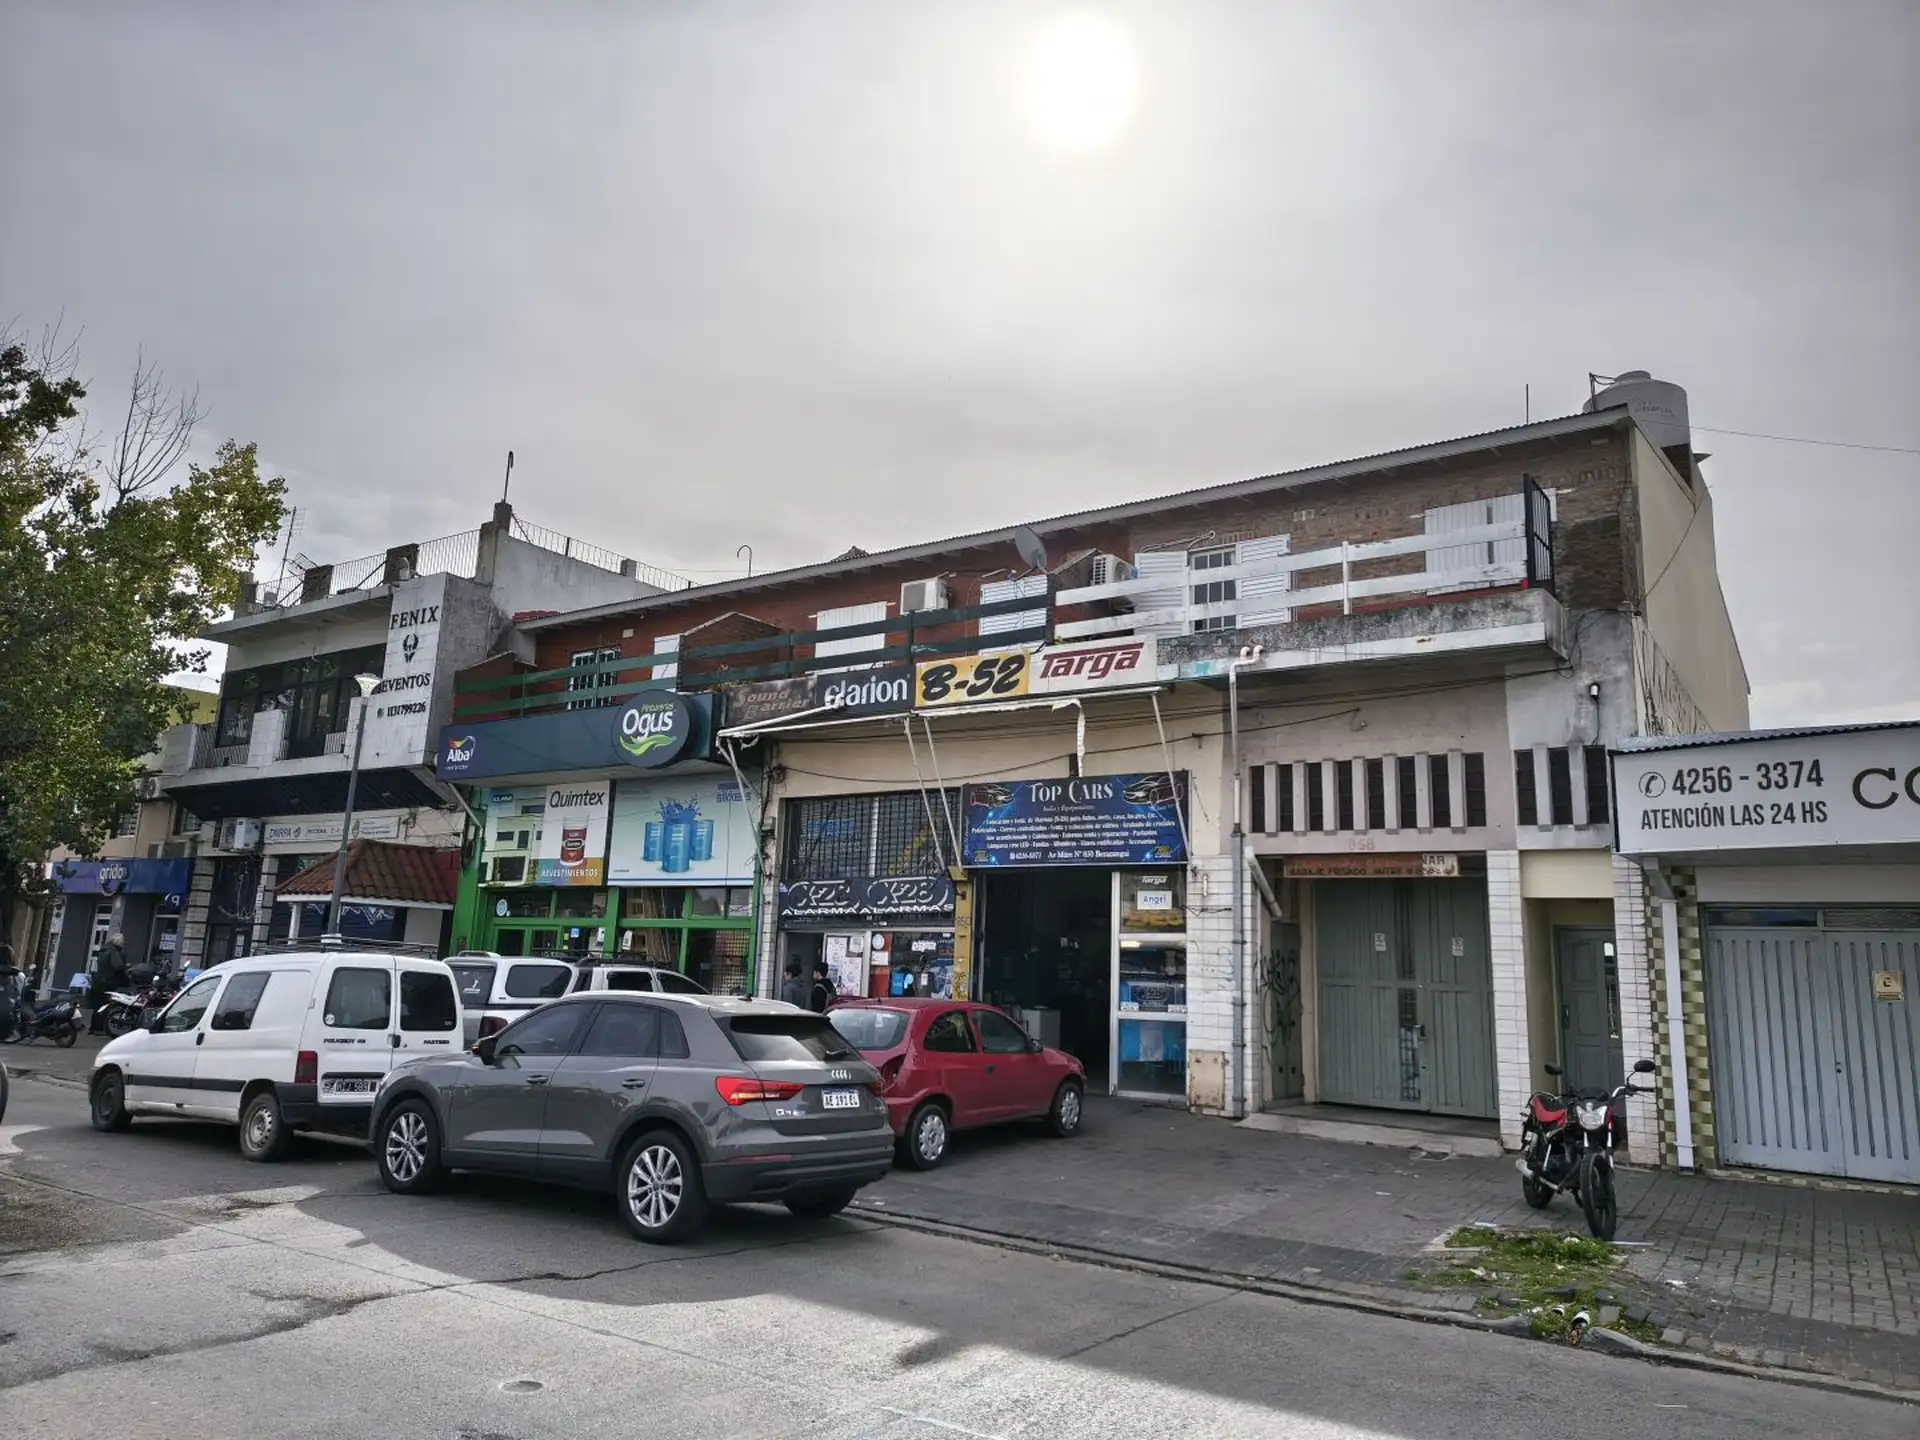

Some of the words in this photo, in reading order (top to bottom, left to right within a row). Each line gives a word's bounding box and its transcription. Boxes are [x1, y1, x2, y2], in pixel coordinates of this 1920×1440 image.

[390, 606, 439, 630] FENIX
[1041, 643, 1143, 679] Targa
[380, 673, 431, 692] EVENTOS
[922, 654, 1025, 702] B-52
[623, 709, 673, 740] Ogus
[446, 748, 471, 763] Alba
[1672, 766, 1732, 795] 4256
[1756, 760, 1823, 790] 3374
[550, 790, 605, 808] Quimtex
[1030, 782, 1062, 802] TOP
[1068, 779, 1113, 804] CARS
[1641, 803, 1725, 830] ATENCIÓN
[1731, 803, 1765, 826] LAS
[1771, 803, 1796, 824] 24
[1801, 801, 1828, 823] HS
[859, 904, 954, 914] ALARMAS
[1143, 894, 1166, 905] Angel
